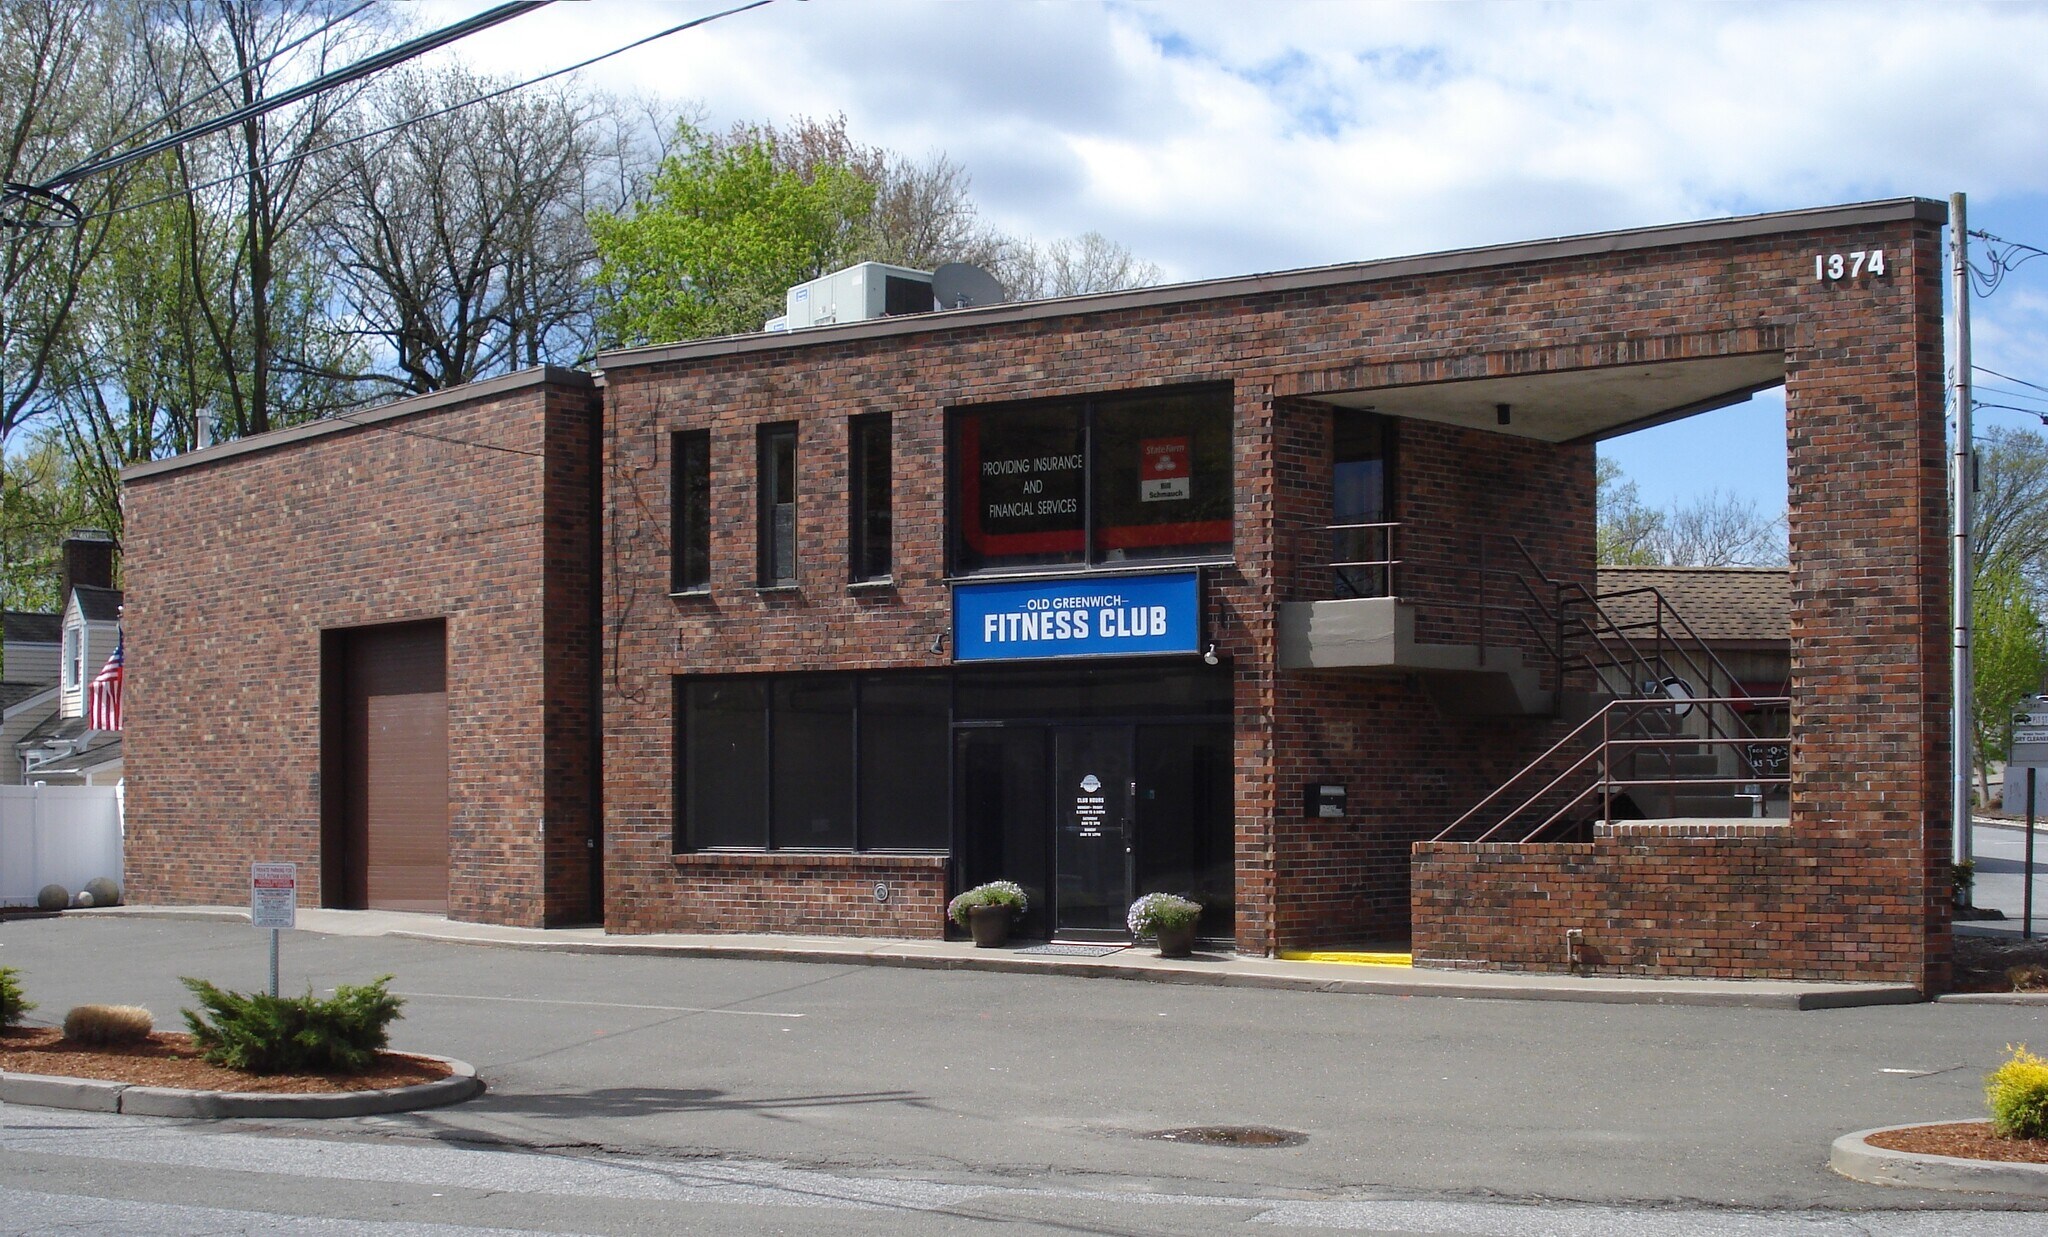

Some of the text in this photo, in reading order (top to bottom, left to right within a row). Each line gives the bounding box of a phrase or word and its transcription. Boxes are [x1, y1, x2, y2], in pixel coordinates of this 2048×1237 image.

[1816, 249, 1885, 280] 1374
[982, 454, 1083, 476] PROVIDING INSURANCE
[1023, 479, 1043, 495] AND
[989, 498, 1077, 518] FINANCIAL SERVICES
[984, 606, 1167, 643] FITNESS CLUB
